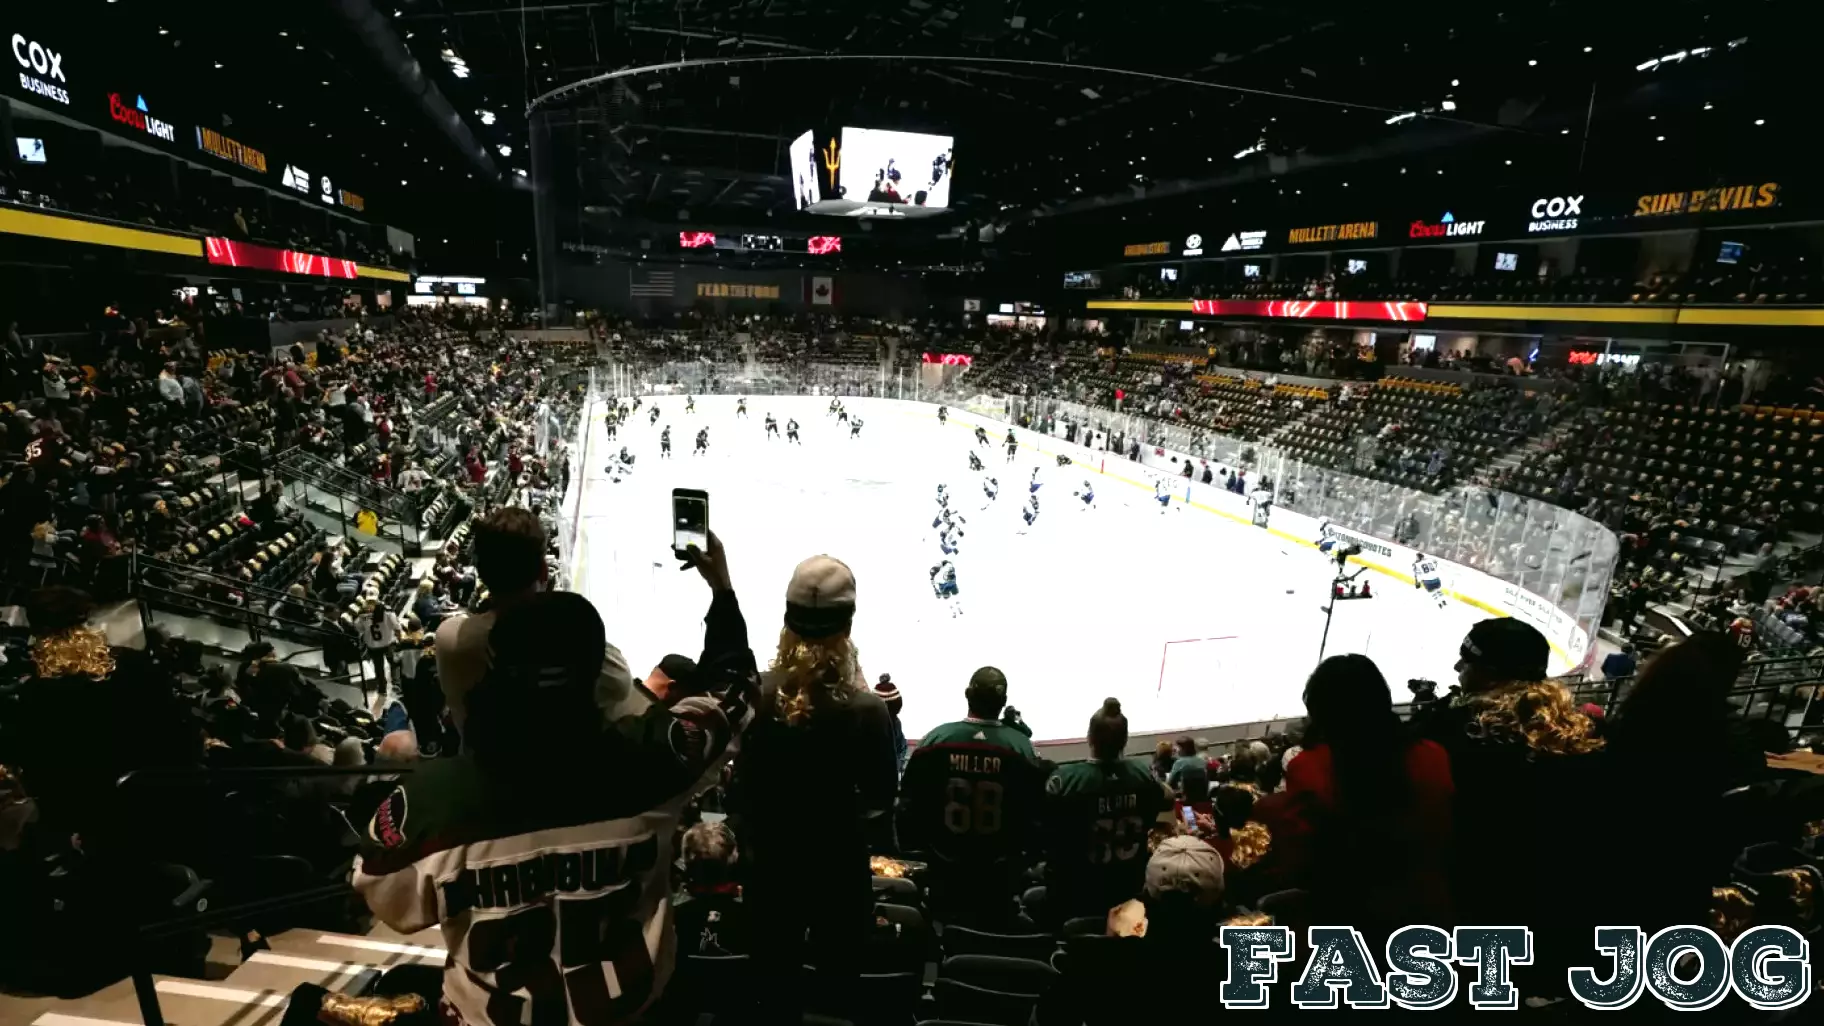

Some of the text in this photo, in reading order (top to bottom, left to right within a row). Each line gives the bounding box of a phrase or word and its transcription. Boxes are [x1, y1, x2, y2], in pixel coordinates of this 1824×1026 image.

[12, 33, 65, 82] COX
[20, 72, 70, 105] BUSINESS
[145, 115, 174, 142] LIGHT
[202, 127, 267, 173] MULLETT ARENA
[1531, 195, 1584, 218] COX
[1634, 193, 1684, 216] SUN
[1289, 225, 1337, 244] MULLETT
[1338, 221, 1375, 240] ARENA
[1446, 220, 1485, 236] LIGHT
[1528, 219, 1578, 232] BUSINESS
[949, 753, 1002, 773] MILLER
[943, 776, 1004, 834] 68
